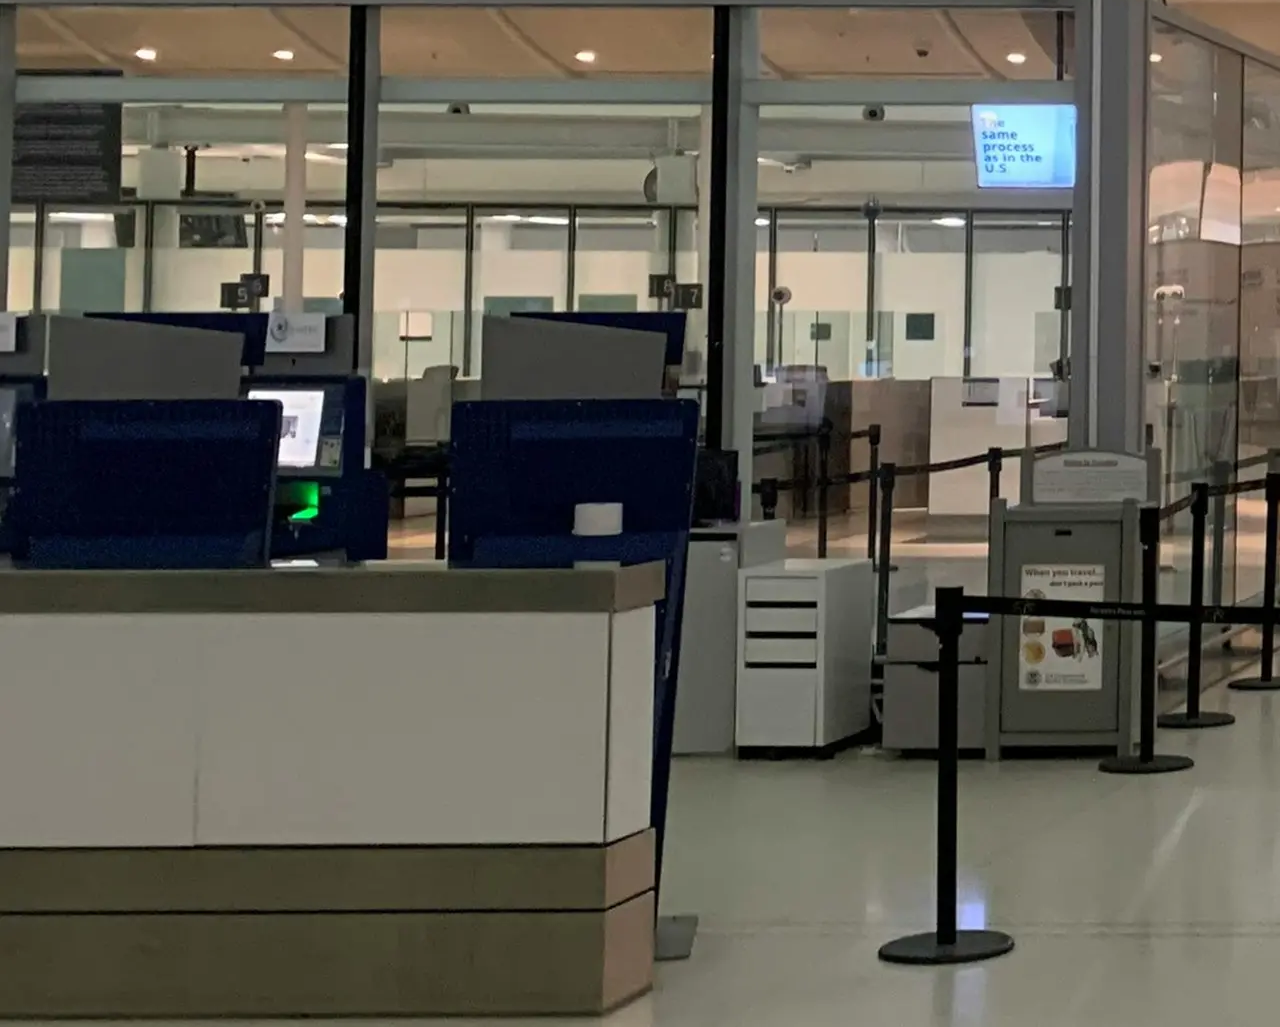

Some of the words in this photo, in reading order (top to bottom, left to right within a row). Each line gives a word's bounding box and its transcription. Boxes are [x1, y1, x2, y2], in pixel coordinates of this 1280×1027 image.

[981, 130, 1018, 140] same
[983, 142, 1035, 154] process
[984, 155, 998, 163] as
[1003, 154, 1016, 163] in
[1020, 154, 1042, 163] the
[237, 287, 247, 304] 5
[689, 288, 698, 303] 7
[1025, 568, 1050, 578] When
[1052, 569, 1068, 580] you
